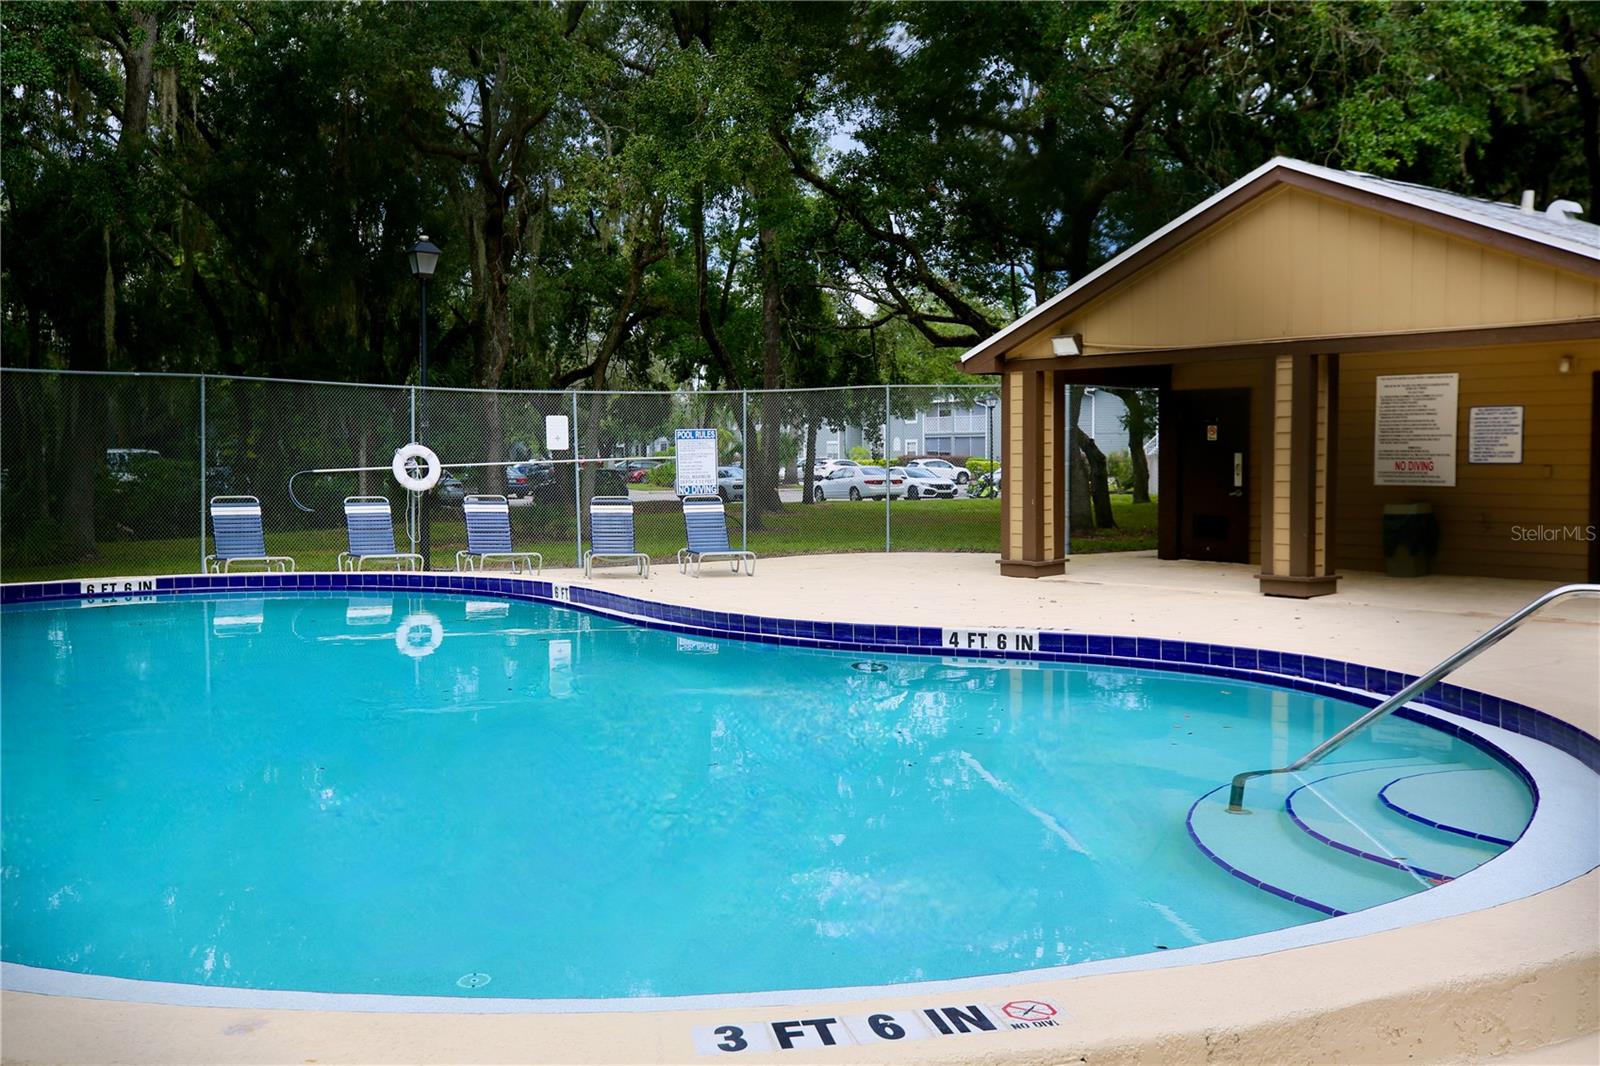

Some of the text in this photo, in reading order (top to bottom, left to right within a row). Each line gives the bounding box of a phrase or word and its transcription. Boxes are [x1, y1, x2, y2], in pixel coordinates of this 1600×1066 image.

[677, 431, 715, 439] POOL RULES
[1394, 460, 1434, 471] NO DIVING
[679, 485, 716, 494] NO DIVING
[86, 581, 152, 594] 6 FT 6 IN
[554, 586, 568, 599] 6 FT
[949, 631, 959, 648] 4
[997, 633, 1007, 650] 6
[713, 1004, 998, 1053] 3 FT 6 IN
[1010, 1022, 1030, 1030] NO
